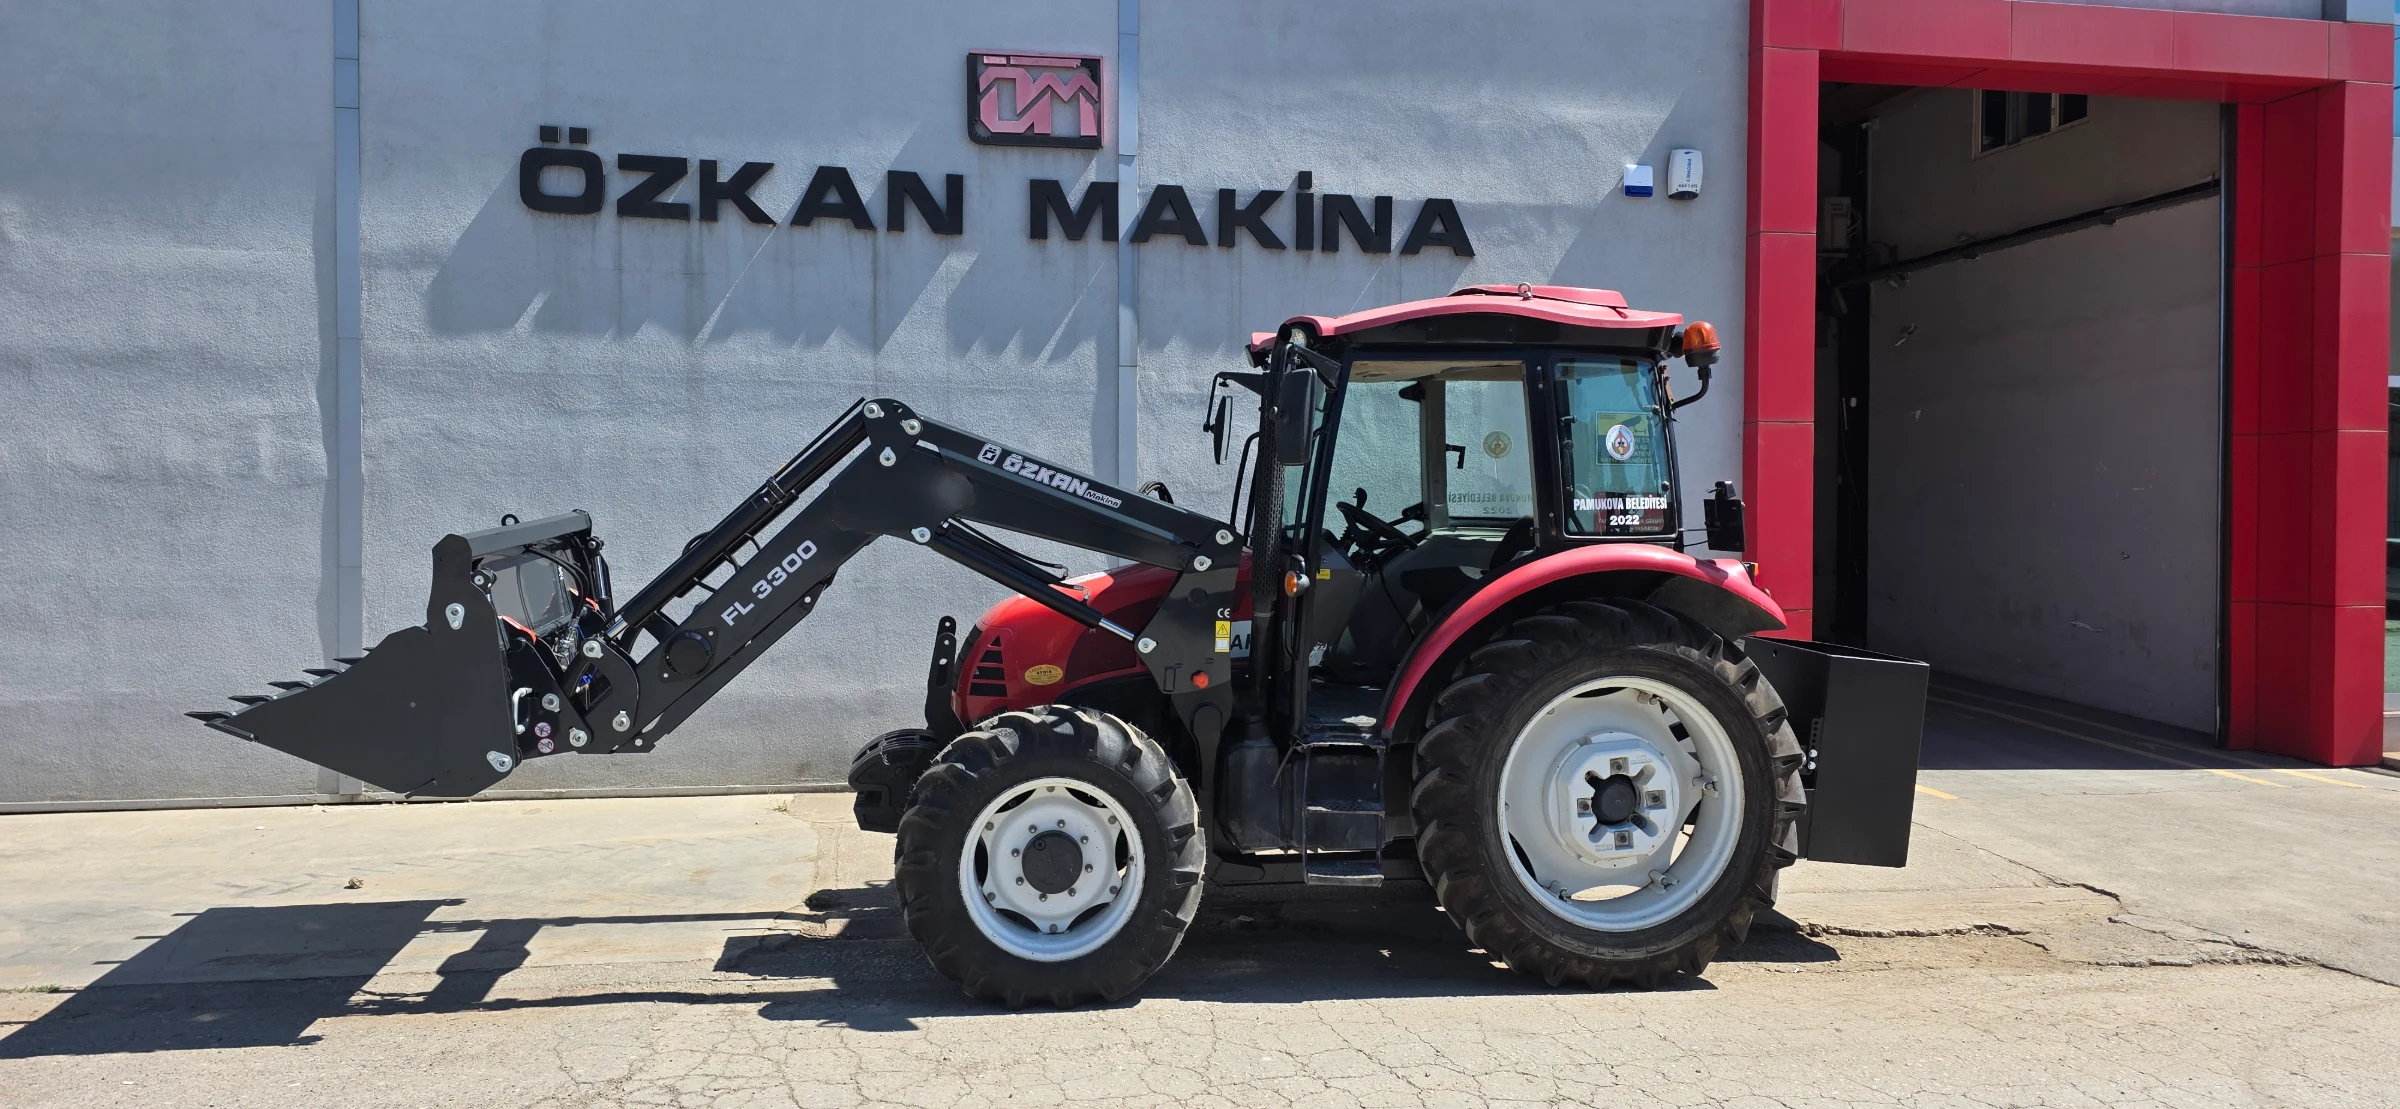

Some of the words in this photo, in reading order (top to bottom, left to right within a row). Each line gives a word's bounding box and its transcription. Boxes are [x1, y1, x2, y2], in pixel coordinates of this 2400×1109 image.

[519, 125, 964, 235] ÖZKAN
[1029, 171, 1476, 257] MAKİNA
[1002, 453, 1089, 497] ÖZKAN
[1086, 491, 1119, 507] Makina
[1573, 498, 1624, 511] PAMUKOVA
[1609, 515, 1640, 526] 2022
[720, 601, 755, 626] FL
[751, 539, 818, 600] 3300
[1217, 608, 1230, 618] CE
